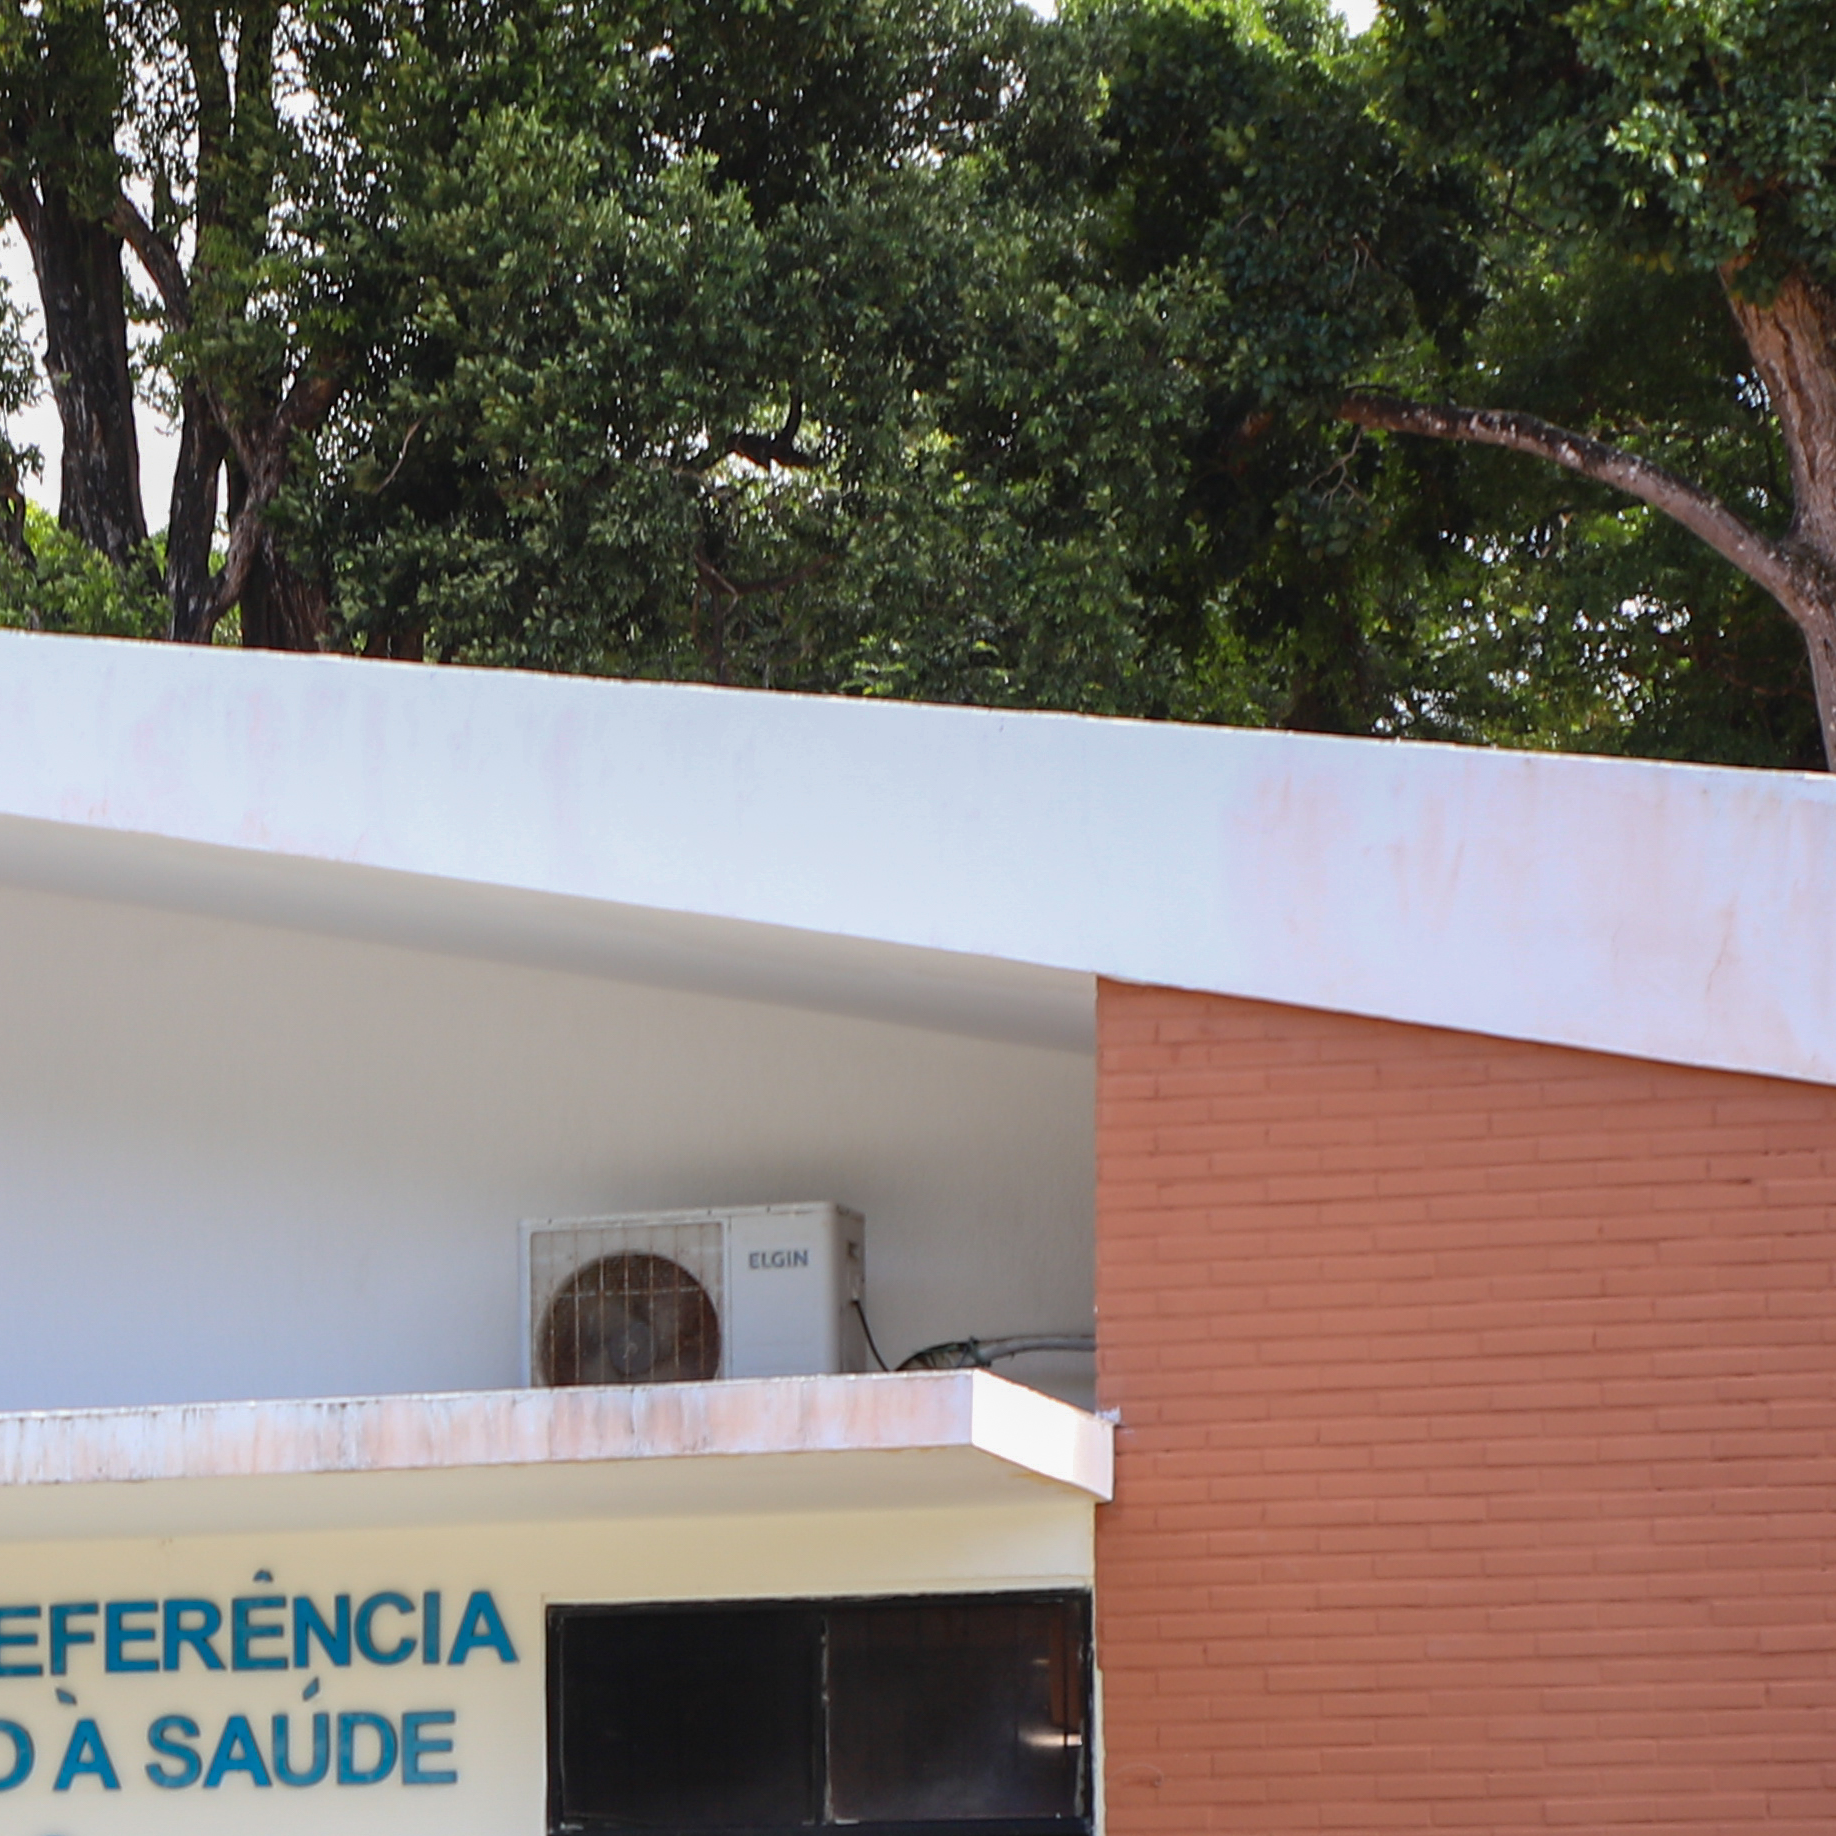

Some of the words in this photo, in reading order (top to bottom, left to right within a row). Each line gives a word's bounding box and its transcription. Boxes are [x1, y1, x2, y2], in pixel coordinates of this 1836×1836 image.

[749, 1249, 809, 1270] ELGIN
[53, 1689, 120, 1792] À
[146, 1677, 459, 1790] SAÚDE
